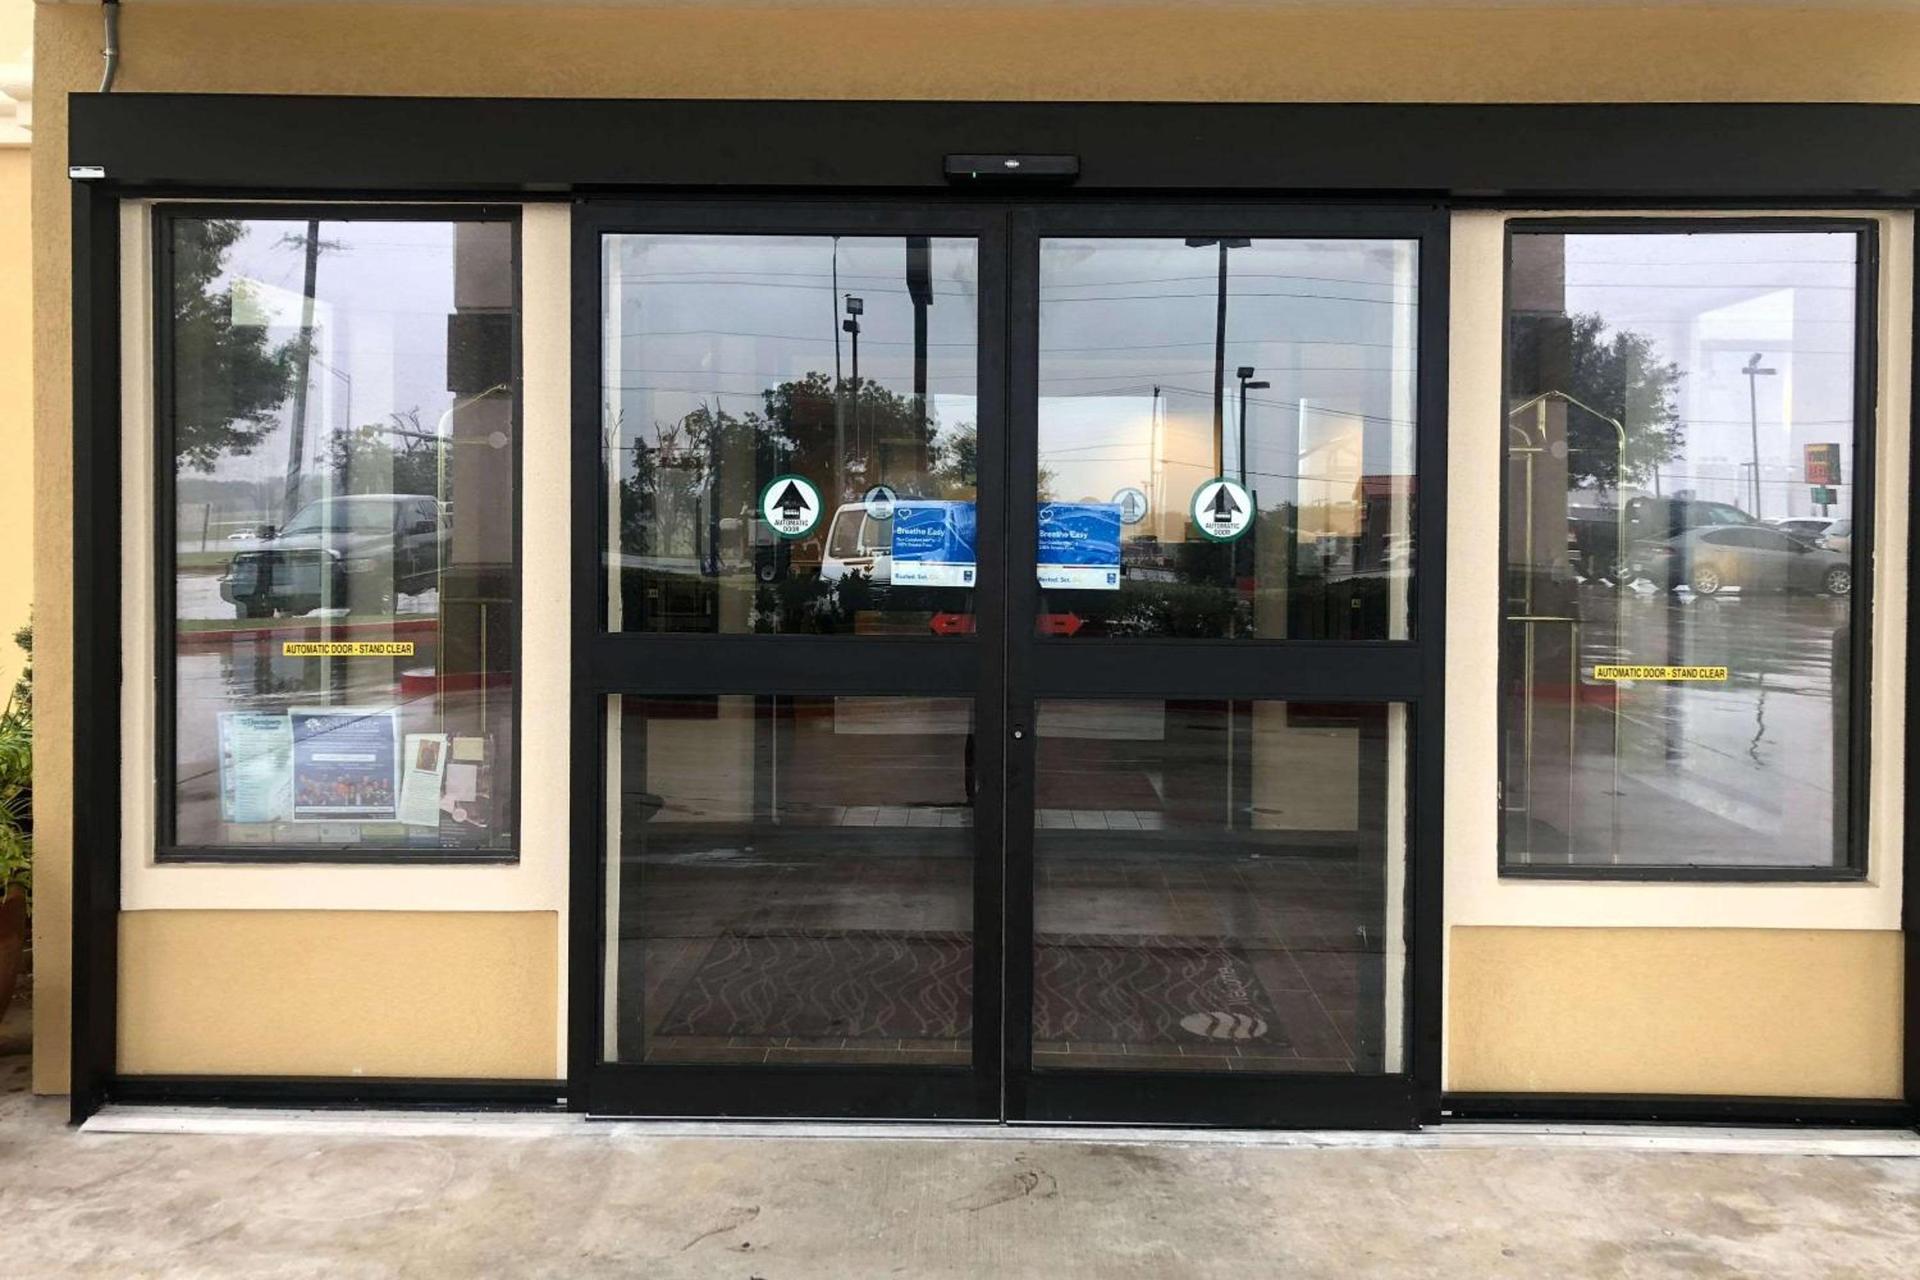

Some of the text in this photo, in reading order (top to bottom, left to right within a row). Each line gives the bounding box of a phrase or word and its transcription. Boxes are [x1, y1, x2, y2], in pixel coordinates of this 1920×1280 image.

[774, 519, 809, 527] AUTOMATIC
[1205, 522, 1240, 530] AUTOMATIC
[896, 527, 945, 537] Breathe Easy
[1039, 529, 1088, 540] Breathe Easy
[286, 644, 329, 653] AUTOMATIC
[331, 644, 353, 653] DOOR
[359, 644, 385, 653] STAND
[386, 645, 412, 653] CLEAR
[1598, 668, 1641, 677] AUTOMATIC
[1643, 668, 1666, 677] DOOR
[1673, 669, 1698, 678] STAND
[1699, 669, 1725, 678] CLEAR
